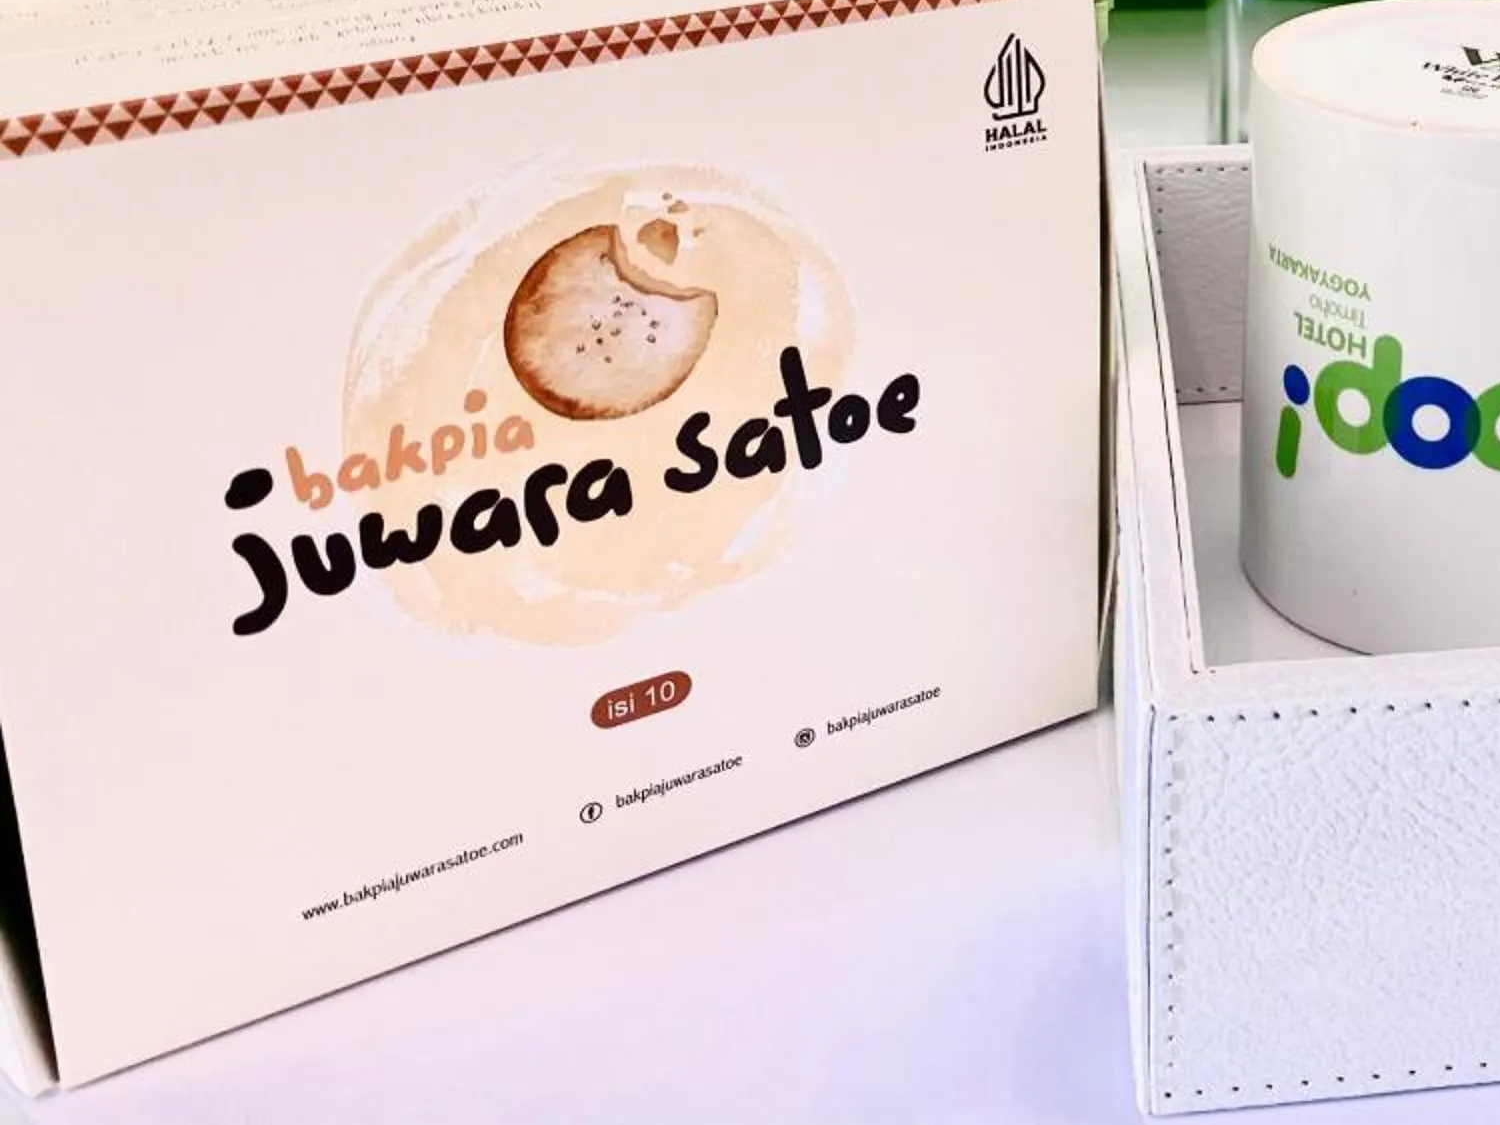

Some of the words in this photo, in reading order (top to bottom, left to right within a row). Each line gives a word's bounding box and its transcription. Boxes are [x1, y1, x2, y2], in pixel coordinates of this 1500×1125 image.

[985, 119, 1047, 143] HALAL
[1269, 242, 1372, 302] YOGYAKARTA
[1294, 311, 1367, 359] HOTEL
[1309, 294, 1366, 330] Timoho
[285, 389, 536, 511] bakpia
[223, 458, 634, 636] juwara
[664, 345, 921, 494] satoe
[606, 692, 636, 721] isi
[644, 681, 676, 709] 10
[825, 686, 942, 736] bakpiajuwarasatoe
[614, 754, 744, 810] bakpiajuwarasatoe
[301, 831, 524, 922] www.bakpiajuwarasatoe.com
